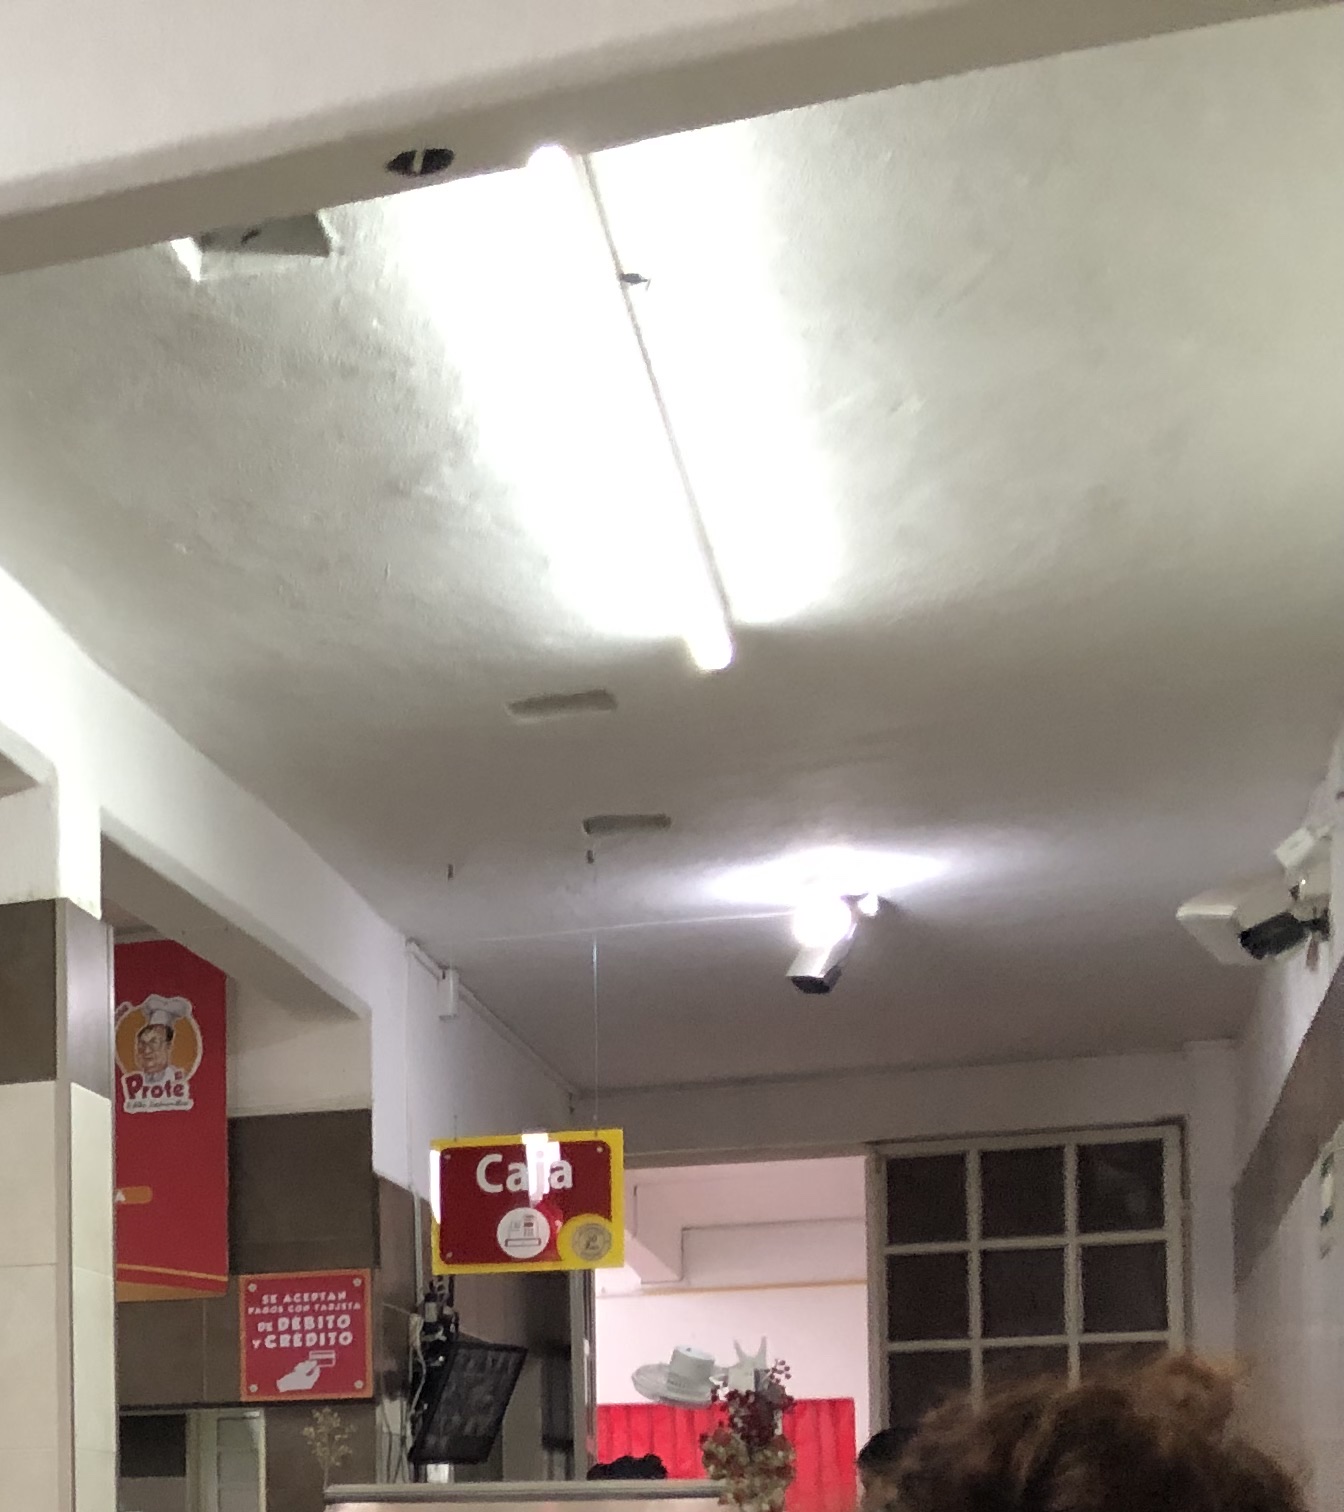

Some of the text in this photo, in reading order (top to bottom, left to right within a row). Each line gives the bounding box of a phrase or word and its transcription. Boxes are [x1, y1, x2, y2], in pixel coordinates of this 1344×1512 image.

[475, 1151, 574, 1201] Caja
[261, 1290, 347, 1305] SE ACEPTAN
[287, 1304, 311, 1313] CON
[257, 1321, 273, 1332] DE
[252, 1339, 262, 1349] Y
